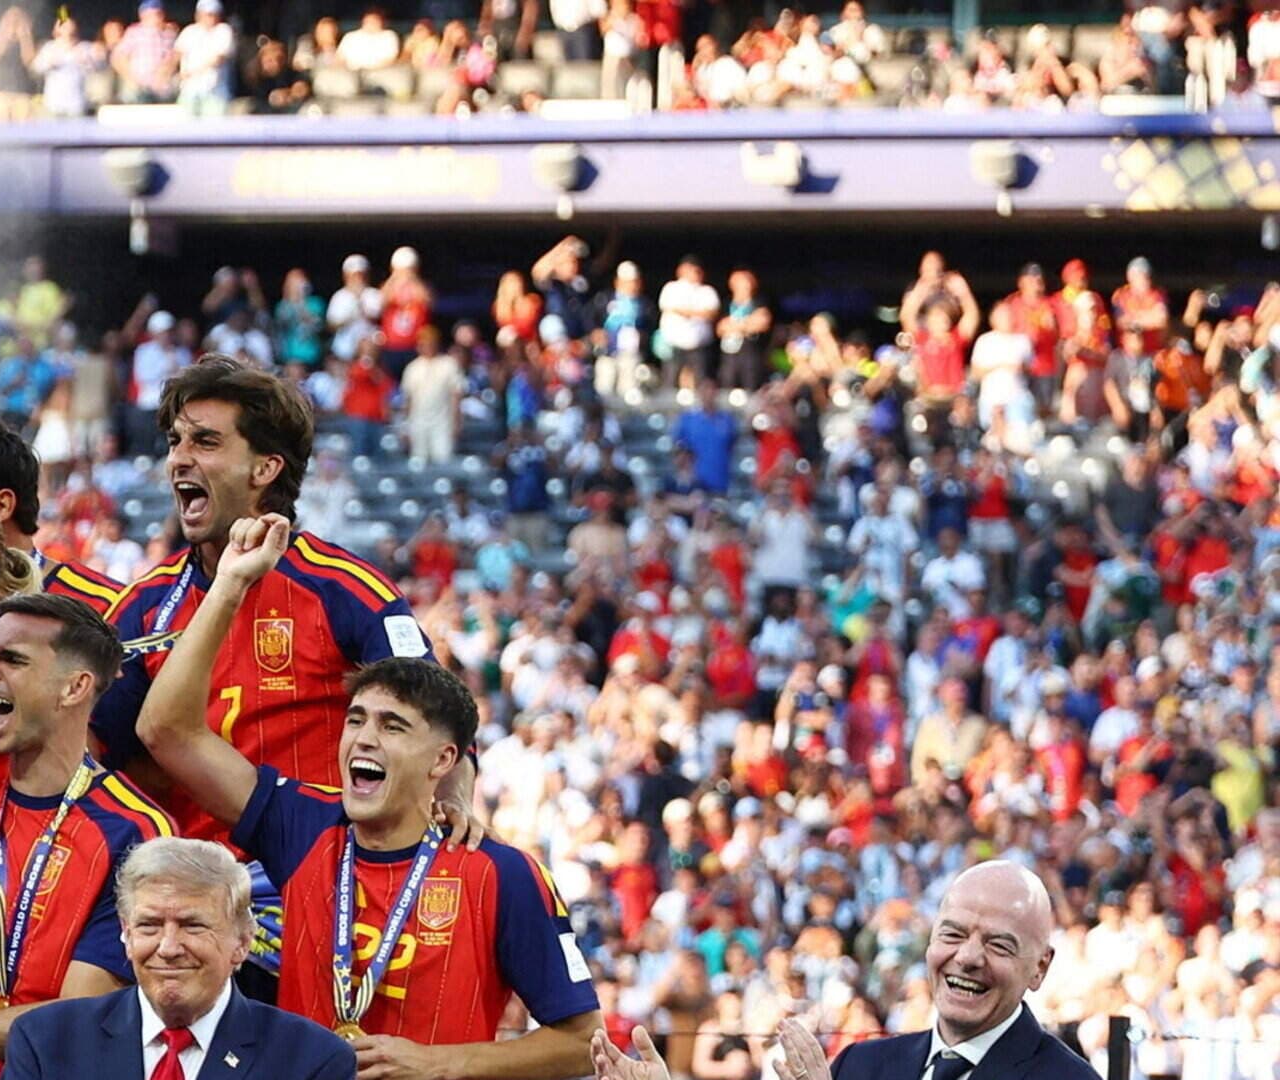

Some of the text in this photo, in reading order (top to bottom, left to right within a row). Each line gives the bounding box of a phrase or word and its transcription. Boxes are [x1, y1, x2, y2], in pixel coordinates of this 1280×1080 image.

[219, 686, 242, 743] 7
[341, 860, 350, 894] WORLD
[20, 890, 31, 911] CUP
[340, 894, 349, 913] CUP
[11, 911, 26, 949] WORLD
[376, 939, 390, 963] FIFA
[387, 905, 407, 940] WORLD
[400, 888, 414, 909] CUP
[7, 950, 17, 972] FIFA
